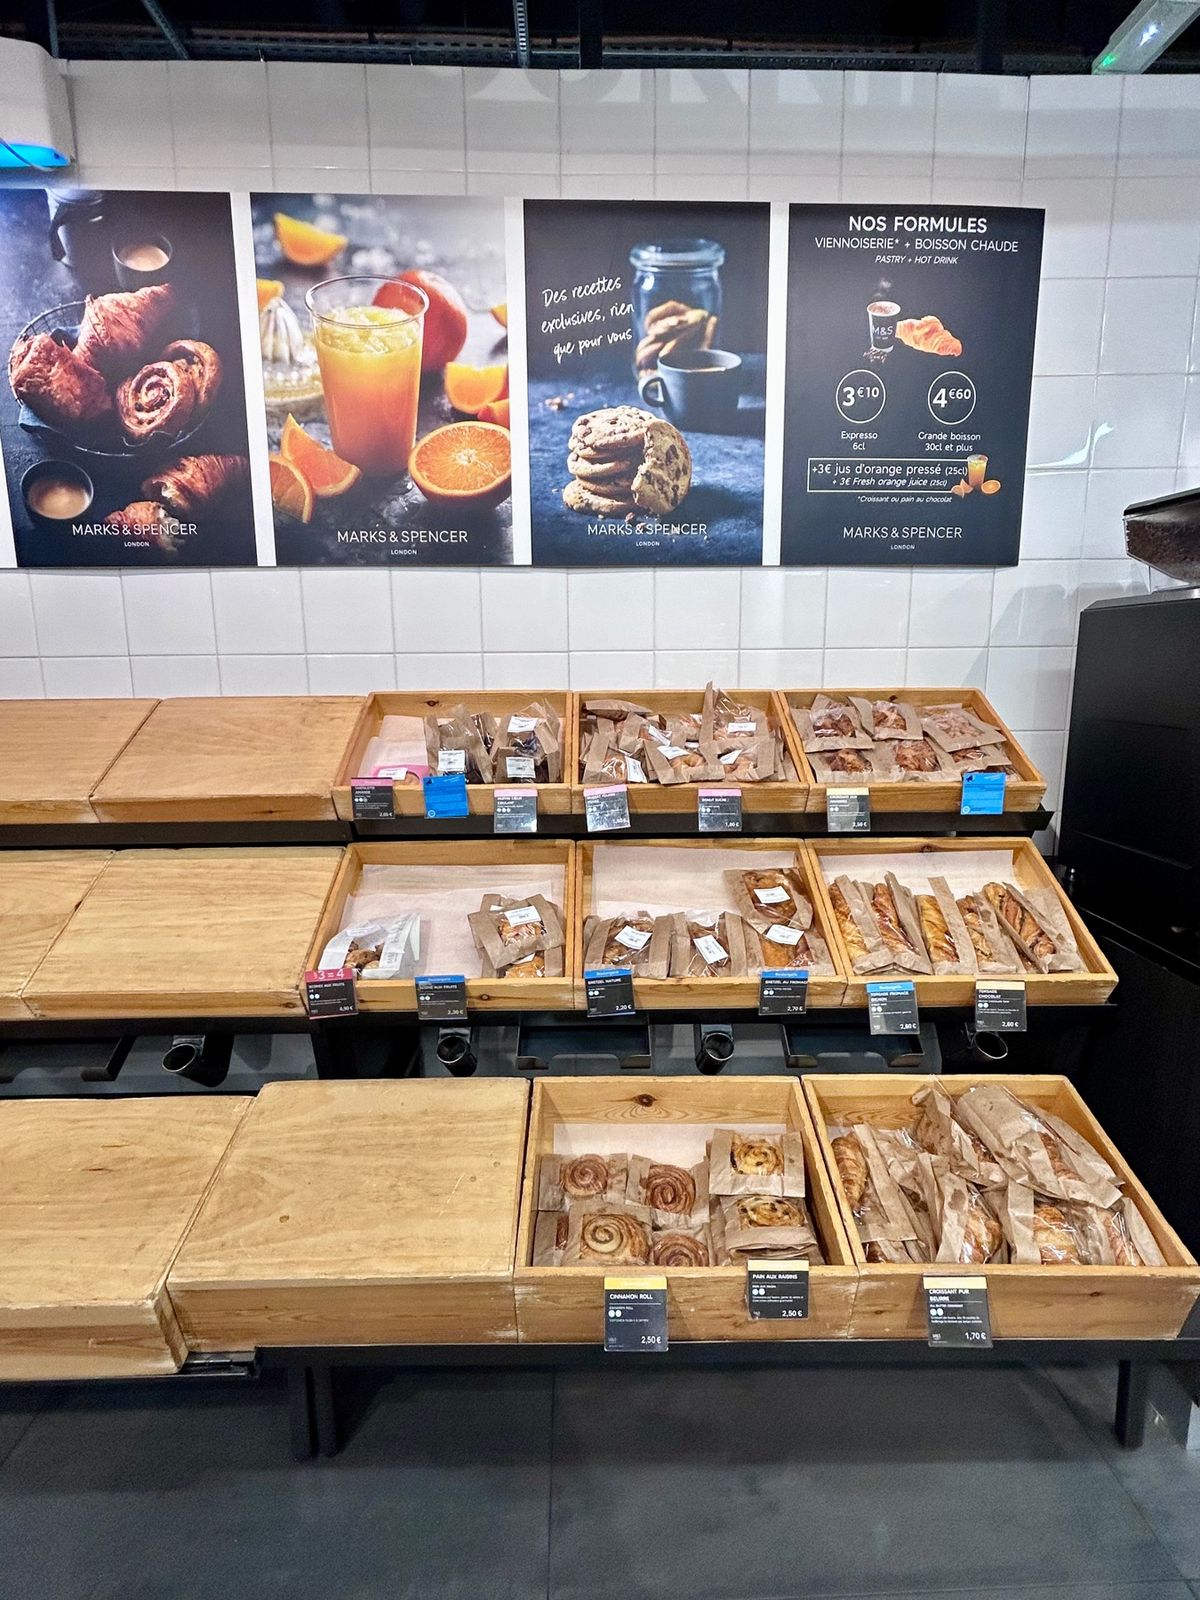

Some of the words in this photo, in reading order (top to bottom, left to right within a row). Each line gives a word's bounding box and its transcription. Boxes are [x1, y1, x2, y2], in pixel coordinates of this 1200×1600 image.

[848, 216, 887, 232] NOS
[894, 216, 988, 234] FORMULES
[914, 238, 968, 251] BOISSON
[970, 239, 1019, 252] CHAUDE
[874, 254, 906, 264] PASTRY
[914, 255, 932, 264] HOT
[933, 256, 958, 265] DRINK
[542, 287, 568, 307] Des
[572, 276, 622, 298] recettes
[540, 310, 606, 334] exclusives,
[610, 302, 634, 318] rien
[872, 325, 894, 336] M&S
[553, 343, 576, 364] que
[578, 336, 604, 357] pour
[606, 328, 633, 344] vous
[840, 431, 878, 440] Expresso
[918, 432, 949, 441] Grande
[950, 432, 981, 441] boisson
[852, 442, 866, 450] 6cl
[925, 442, 943, 452] 30cl
[944, 443, 954, 452] et
[956, 443, 974, 452] plus
[812, 464, 832, 474] +3€
[834, 464, 851, 476] jus
[855, 464, 903, 476] d'orange
[906, 464, 942, 476] pressé
[944, 466, 968, 476] (25cl)
[840, 478, 851, 486] 3€
[852, 478, 876, 486] Fresh
[878, 479, 906, 487] orange
[908, 478, 928, 487] juice
[900, 496, 915, 504] pain
[72, 524, 120, 536] MARKS
[122, 523, 132, 536] &
[133, 523, 198, 536] SPENCER
[587, 524, 633, 536] MARKS
[634, 524, 644, 536] &
[646, 523, 707, 536] SPENCER
[843, 527, 889, 539] MARKS
[890, 526, 900, 539] &
[901, 526, 963, 539] SPENCER
[337, 530, 387, 543] MARKS
[389, 530, 399, 543] &
[400, 530, 468, 543] SPENCER
[318, 970, 326, 980] 3
[336, 969, 344, 978] 4
[640, 1335, 656, 1345] 2,50
[965, 1332, 981, 1341] 1,70
